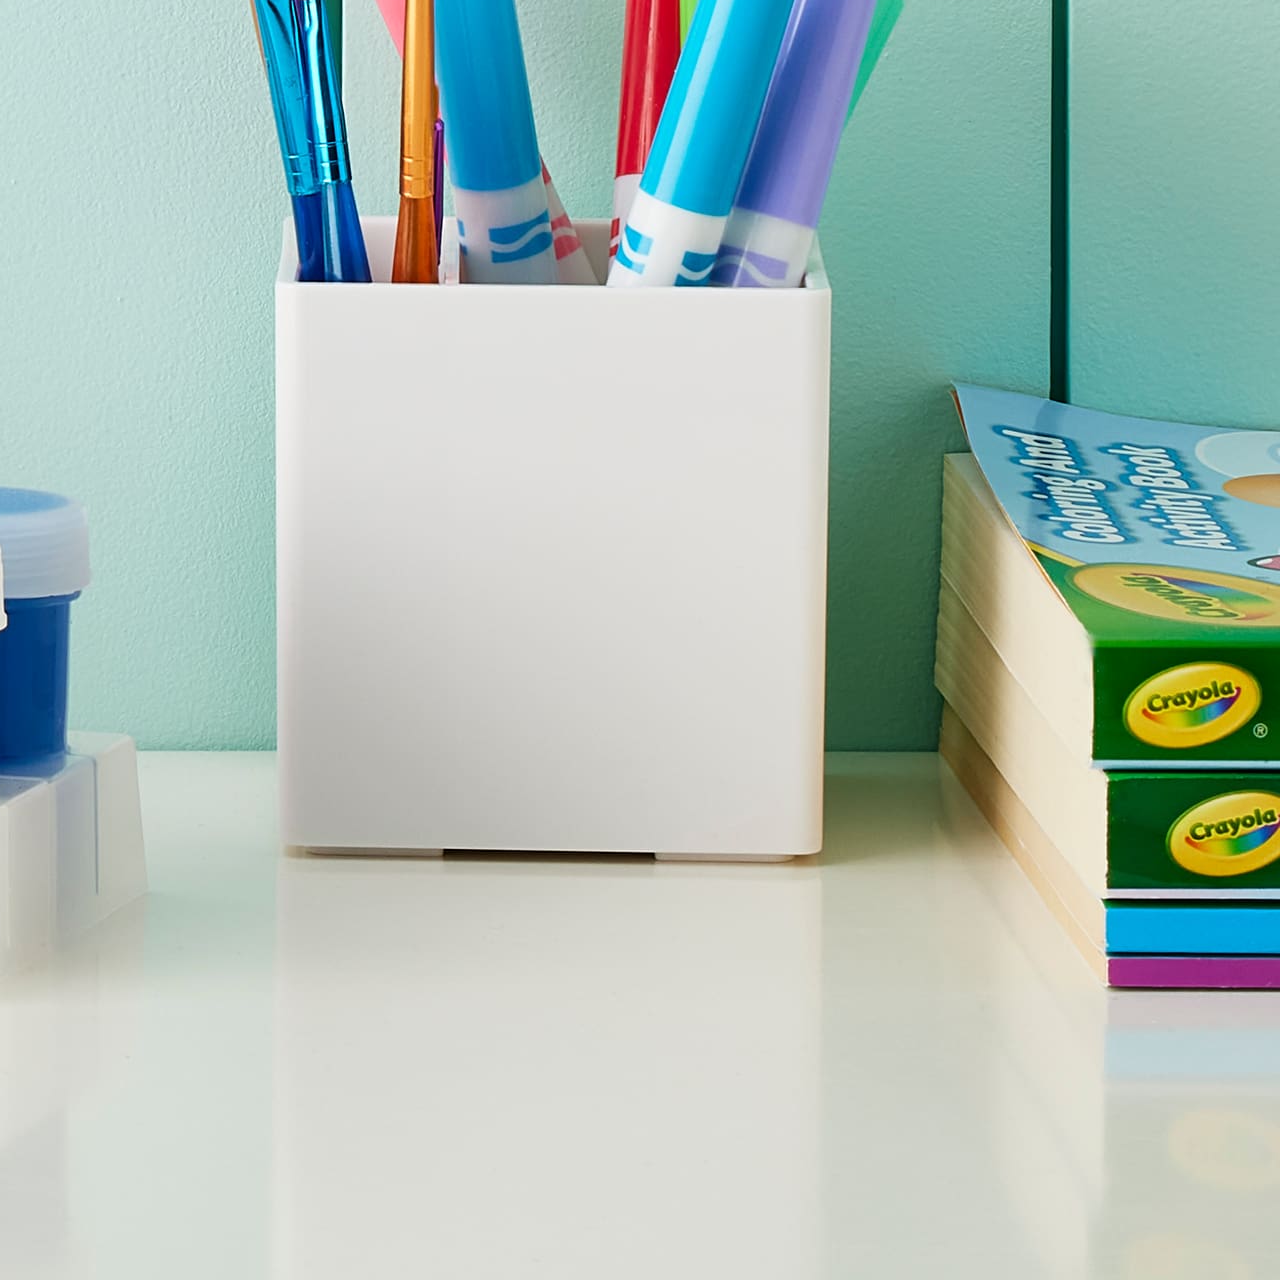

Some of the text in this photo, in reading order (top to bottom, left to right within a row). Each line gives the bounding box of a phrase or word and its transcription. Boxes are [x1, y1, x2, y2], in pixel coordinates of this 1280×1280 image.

[1001, 428, 1126, 543] Coloring And
[1107, 444, 1238, 550] Activity Book
[1120, 574, 1240, 618] Crayola
[1146, 679, 1236, 713] Crayola
[1188, 807, 1278, 842] Crayola
